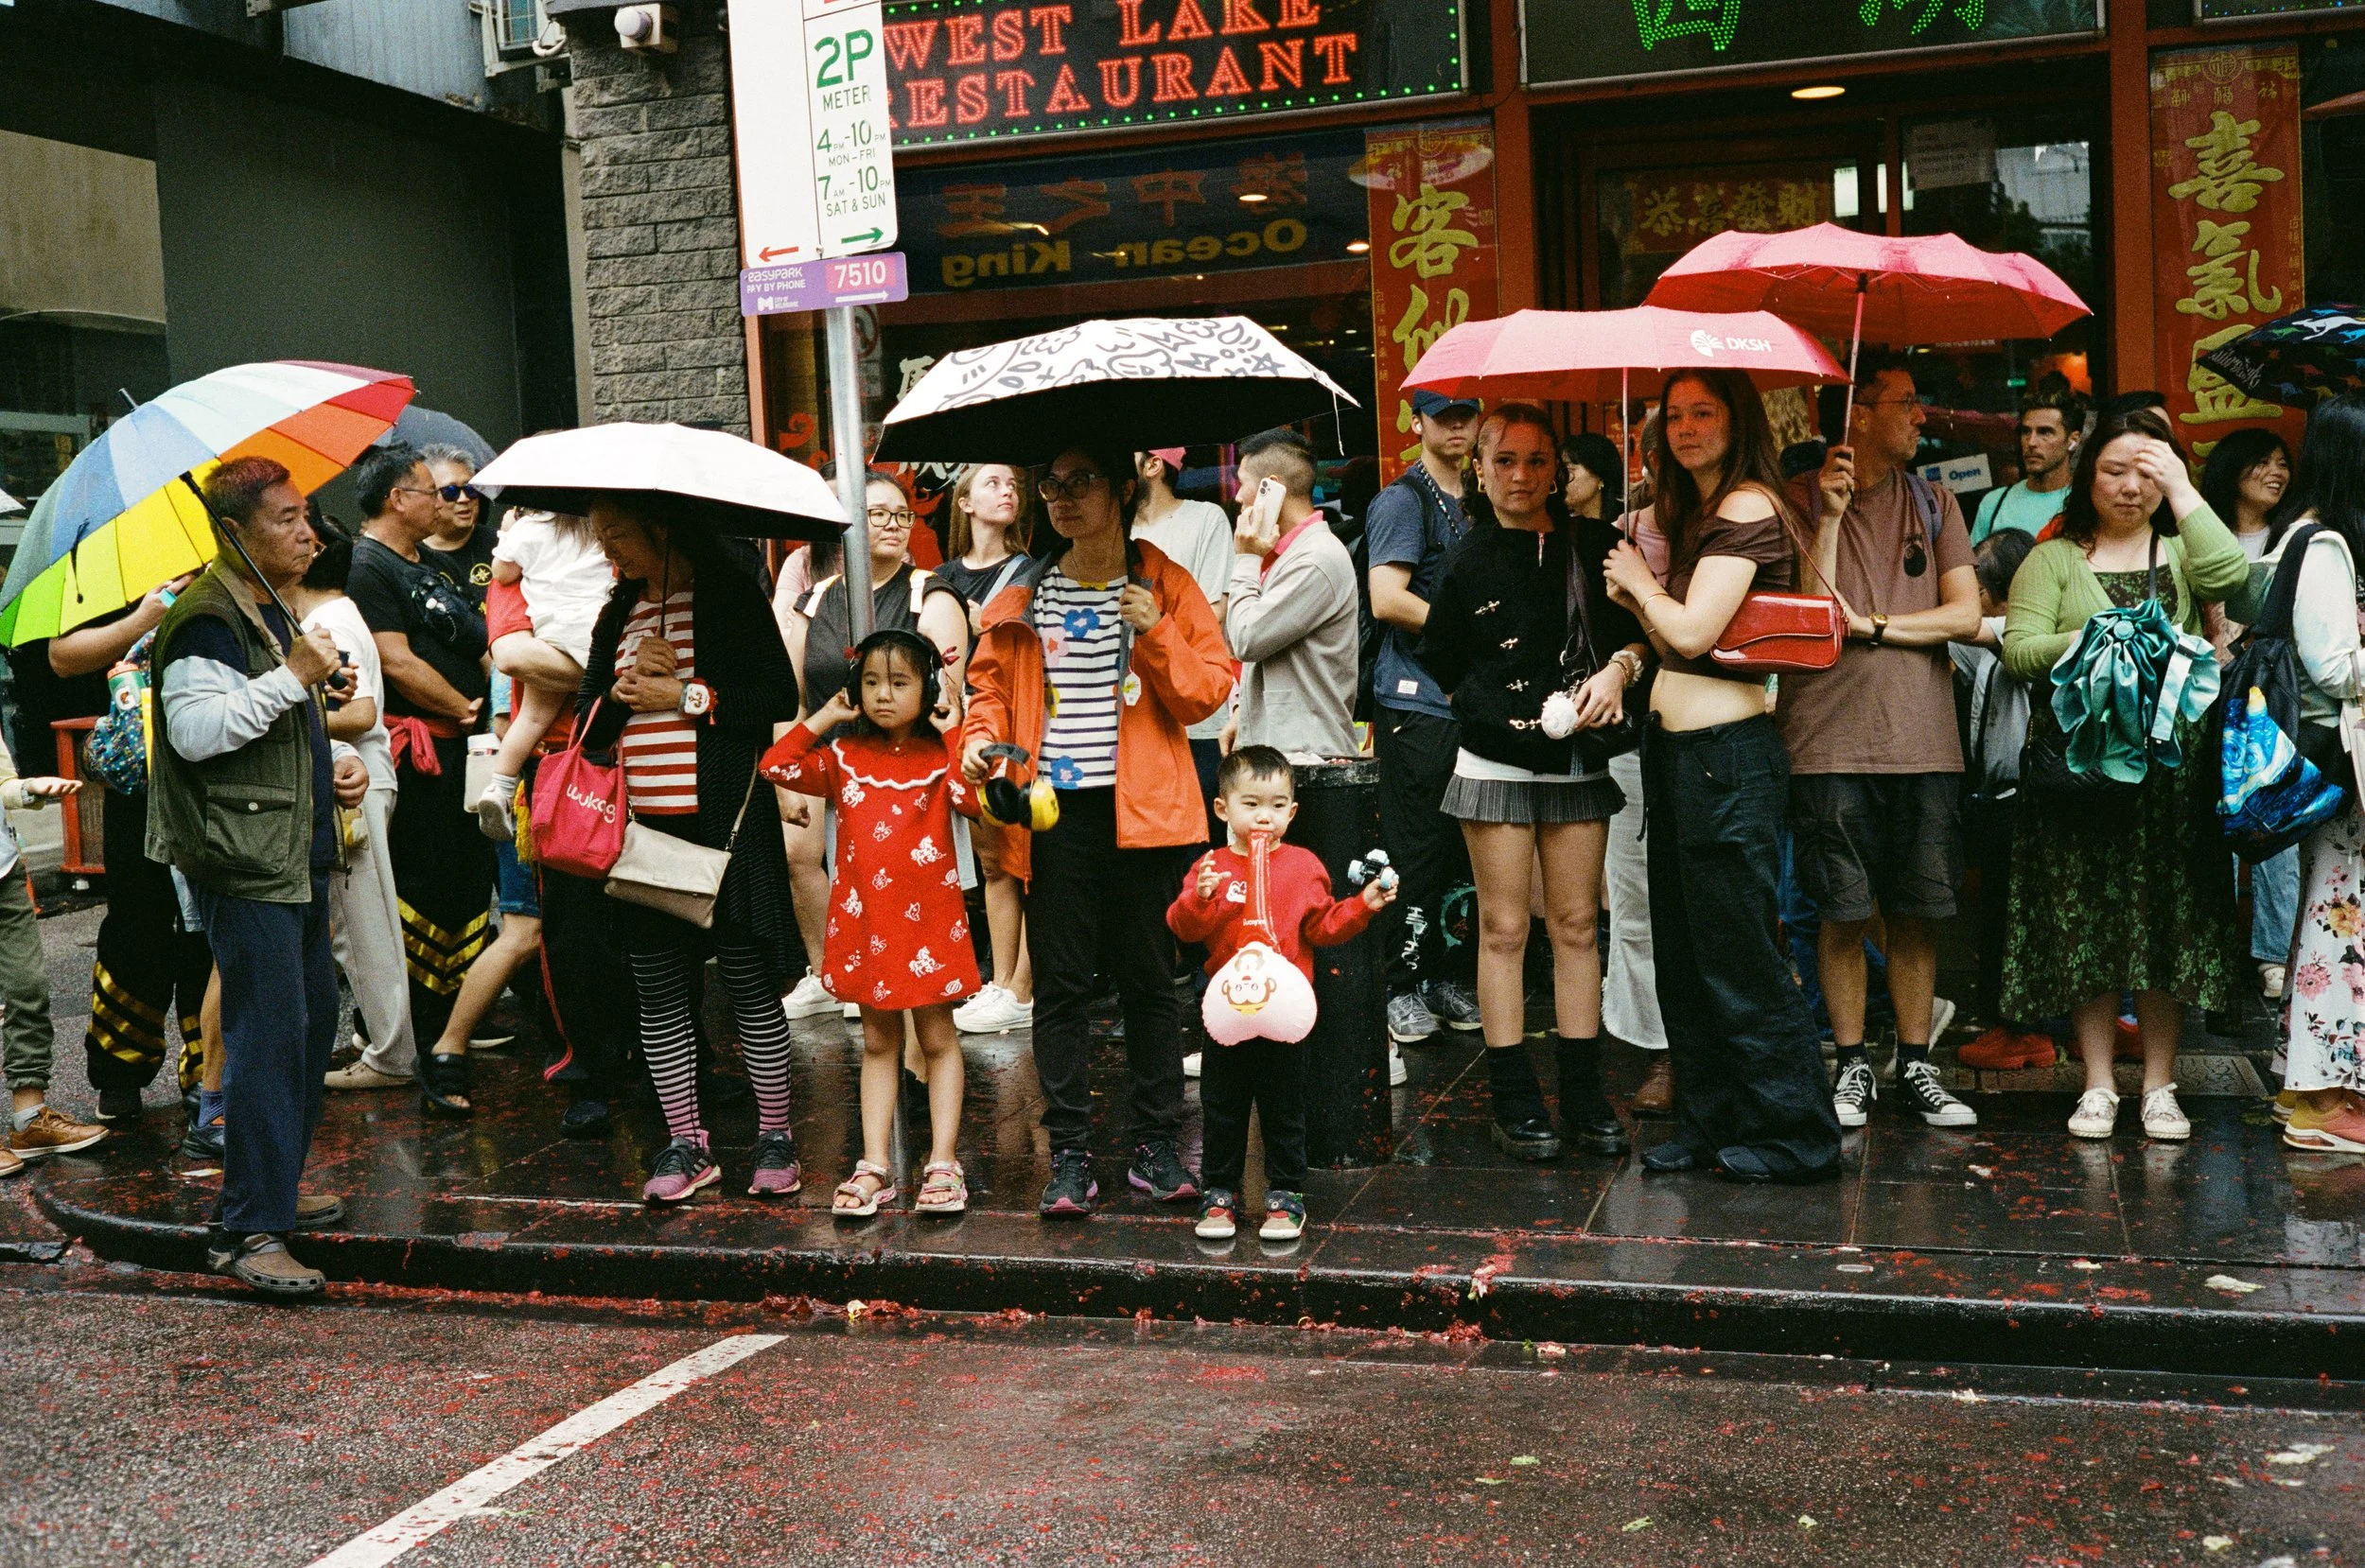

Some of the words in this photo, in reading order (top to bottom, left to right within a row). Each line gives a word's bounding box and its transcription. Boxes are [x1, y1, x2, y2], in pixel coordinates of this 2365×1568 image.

[884, 5, 1074, 71] WEST
[1119, 0, 1321, 45] LAKE
[814, 28, 874, 89] 2P
[885, 33, 1358, 130] ESTAURANT
[822, 84, 871, 112] METER
[826, 200, 848, 218] SAT
[862, 192, 886, 210] SUN
[746, 283, 762, 294] PAY
[763, 282, 776, 292] BY
[777, 279, 806, 291] PHONE
[834, 260, 886, 288] 7510
[2168, 111, 2285, 488] 喜氣盈
[1726, 337, 1772, 353] DKSH
[1949, 468, 1982, 481] Open
